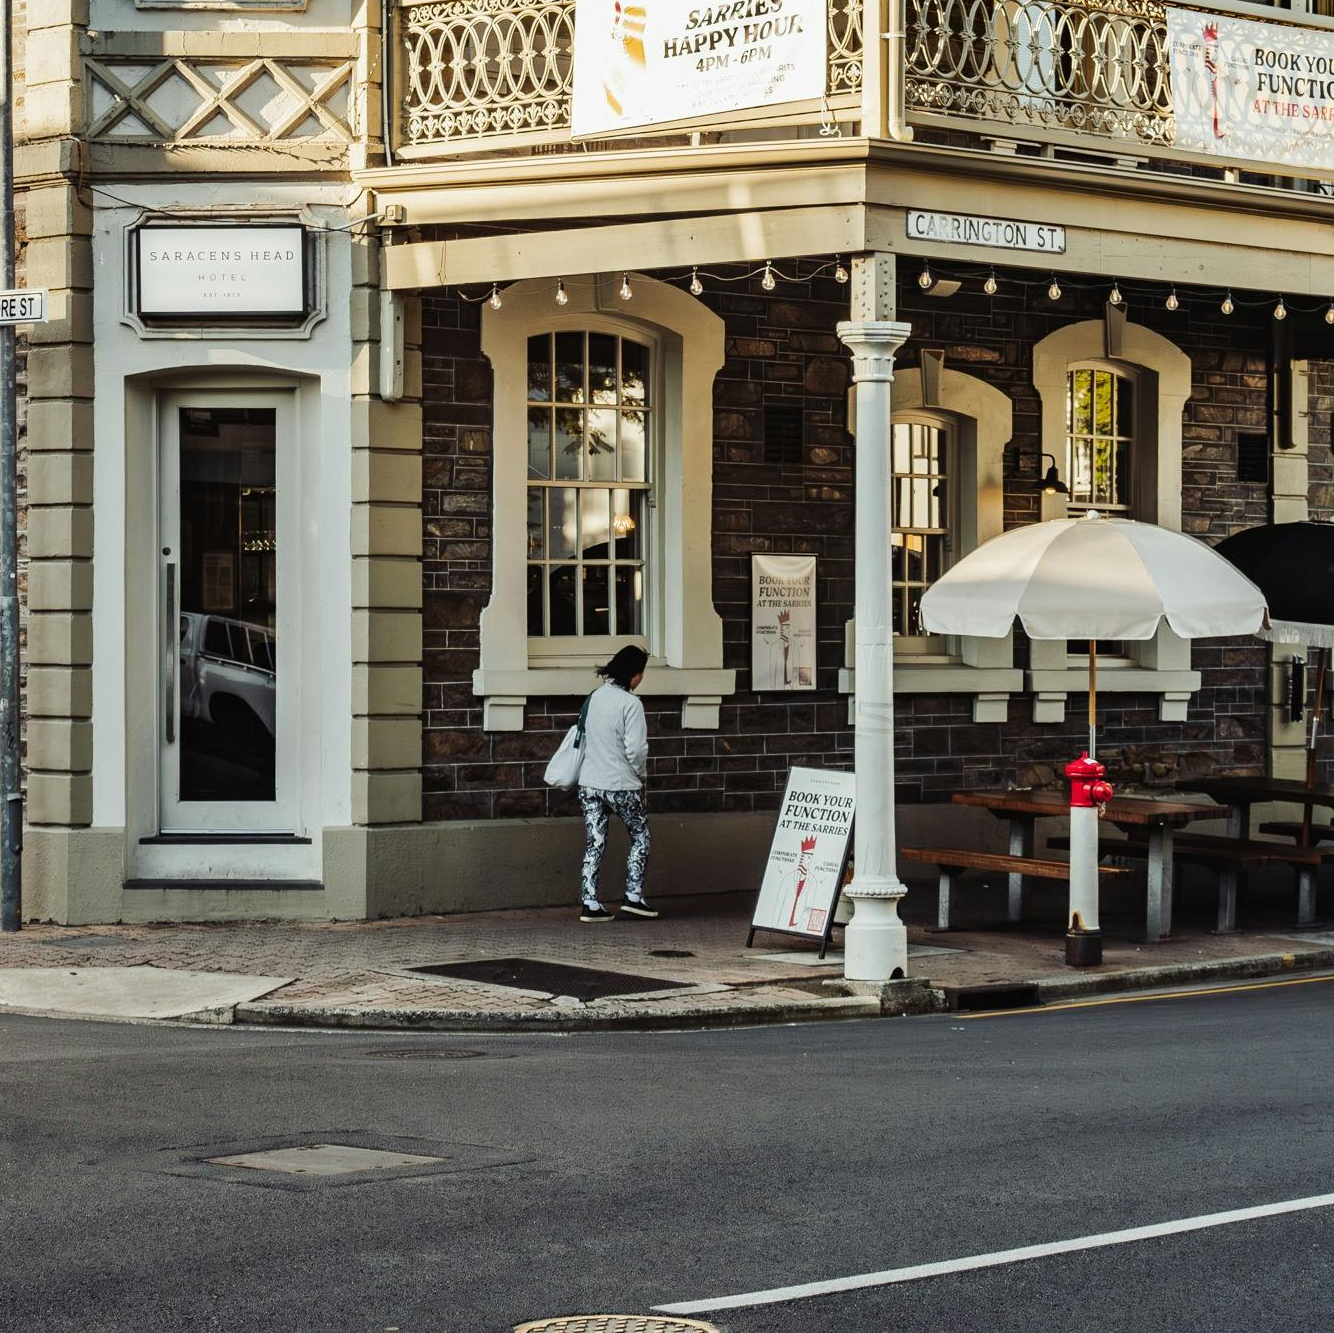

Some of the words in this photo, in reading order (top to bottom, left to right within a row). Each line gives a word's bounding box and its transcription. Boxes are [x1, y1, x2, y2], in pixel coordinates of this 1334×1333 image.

[663, 27, 738, 58] HAPPY
[743, 14, 803, 44] HOUR
[696, 54, 730, 72] 4PM
[740, 46, 772, 64] 6PM
[1254, 48, 1301, 71] BOOK
[1253, 99, 1270, 113] AT
[1273, 101, 1299, 117] THE
[915, 215, 1027, 246] CARRINGTON
[150, 251, 242, 261] SARACENS
[250, 250, 294, 261] HEAD
[198, 273, 247, 282] HOTEL
[19, 297, 34, 317] ST
[759, 575, 784, 585] BOOK
[787, 576, 810, 586] YOUR
[759, 587, 810, 597] FUNCTION
[783, 599, 812, 607] SARRIES
[788, 790, 822, 804] BOOK
[823, 794, 853, 808] YOUR
[785, 804, 850, 823] FUNCTION
[779, 819, 793, 829] AT
[793, 821, 812, 832] THE
[811, 823, 849, 836] SARRIES
